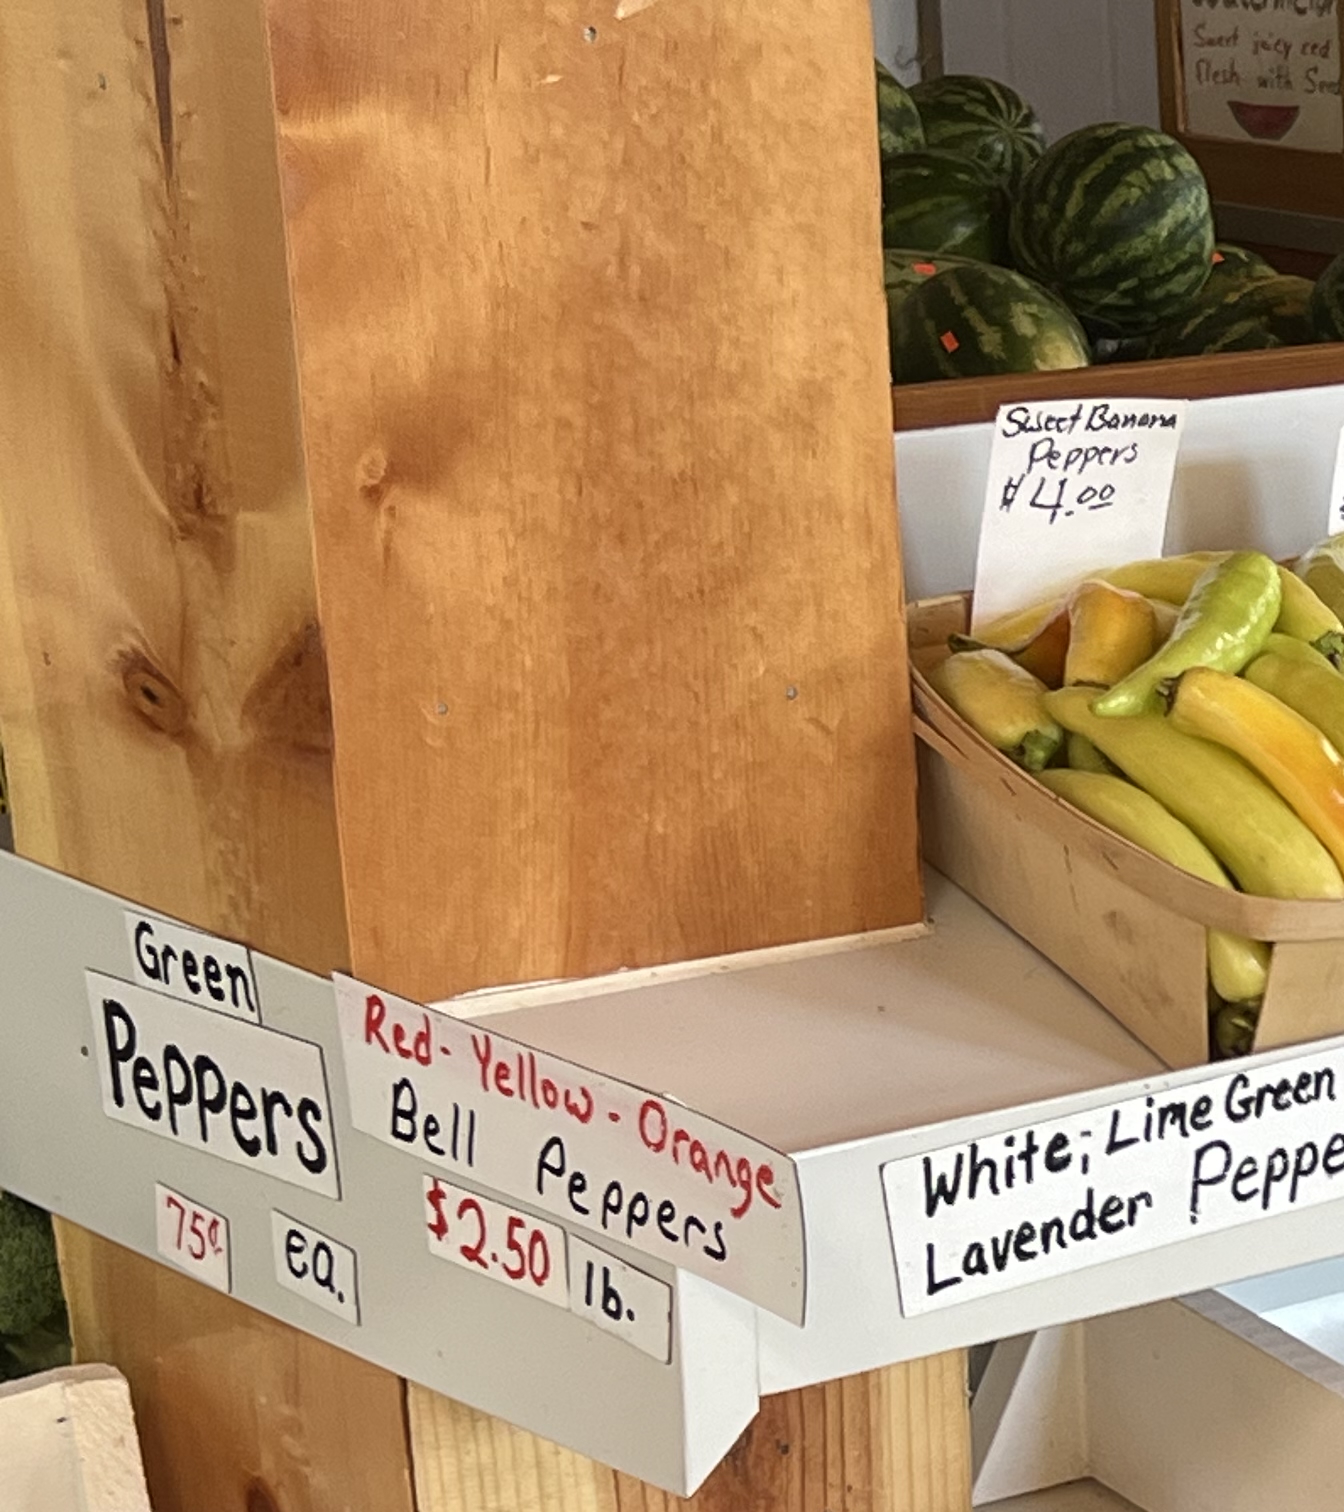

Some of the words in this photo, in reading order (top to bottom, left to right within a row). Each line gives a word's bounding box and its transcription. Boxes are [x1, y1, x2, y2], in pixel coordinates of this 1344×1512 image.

[1002, 403, 1082, 438] Sweet
[1085, 403, 1178, 430] Banana
[1027, 437, 1138, 475] Peppers
[1000, 473, 1116, 525] $4.00
[134, 920, 256, 1012] Green
[101, 997, 329, 1175] Peppers
[1105, 1084, 1212, 1157] Lime
[390, 1078, 477, 1167] Bell
[537, 1136, 729, 1262] Peppers
[636, 1099, 783, 1219] Orange
[285, 1228, 346, 1304] ea.
[425, 1178, 551, 1288] $2.50
[584, 1260, 635, 1322] lb.
[925, 1188, 1154, 1296] Lavender
